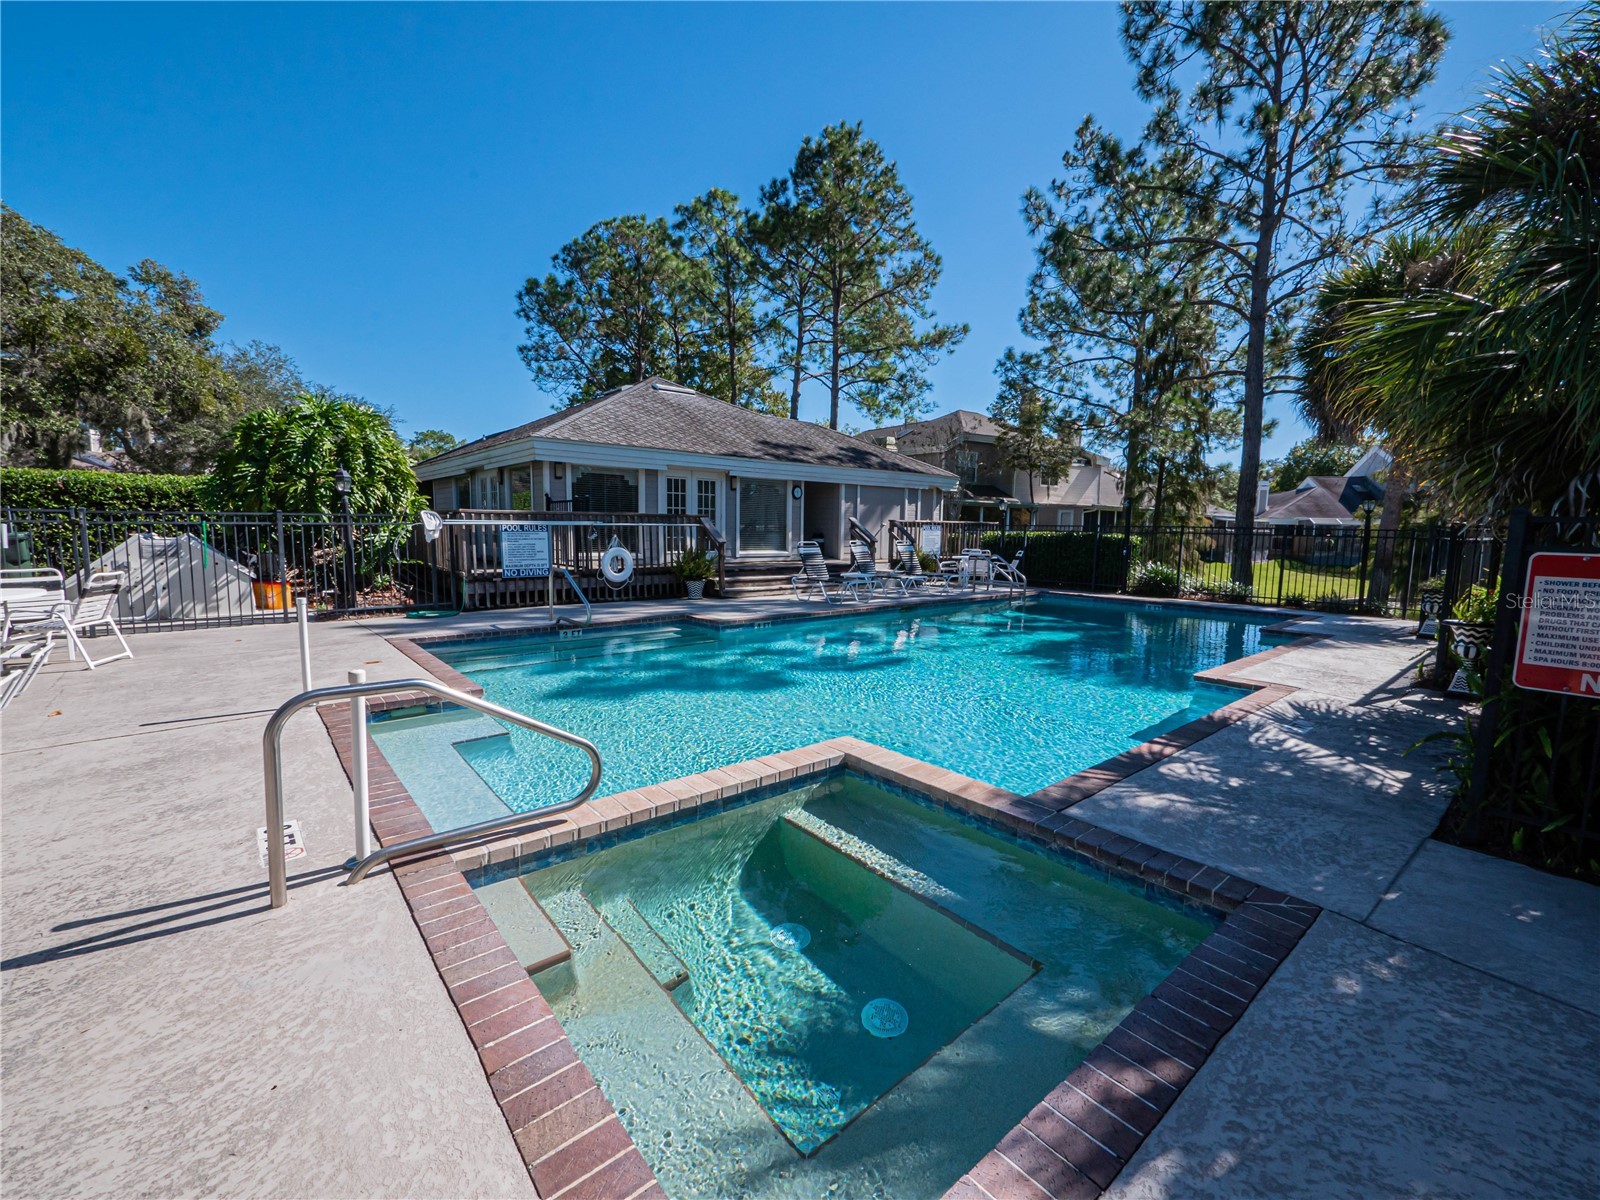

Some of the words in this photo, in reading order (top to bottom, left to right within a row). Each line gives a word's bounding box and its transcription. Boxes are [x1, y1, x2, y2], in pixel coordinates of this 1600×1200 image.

[1540, 611, 1585, 619] PROBLEMS
[1538, 625, 1574, 633] WITHOUT
[1536, 633, 1580, 642] MAXIMUM
[1536, 641, 1576, 650] CHILDREN
[1534, 648, 1577, 658] MAXIMUM
[1550, 658, 1580, 667] HOURS
